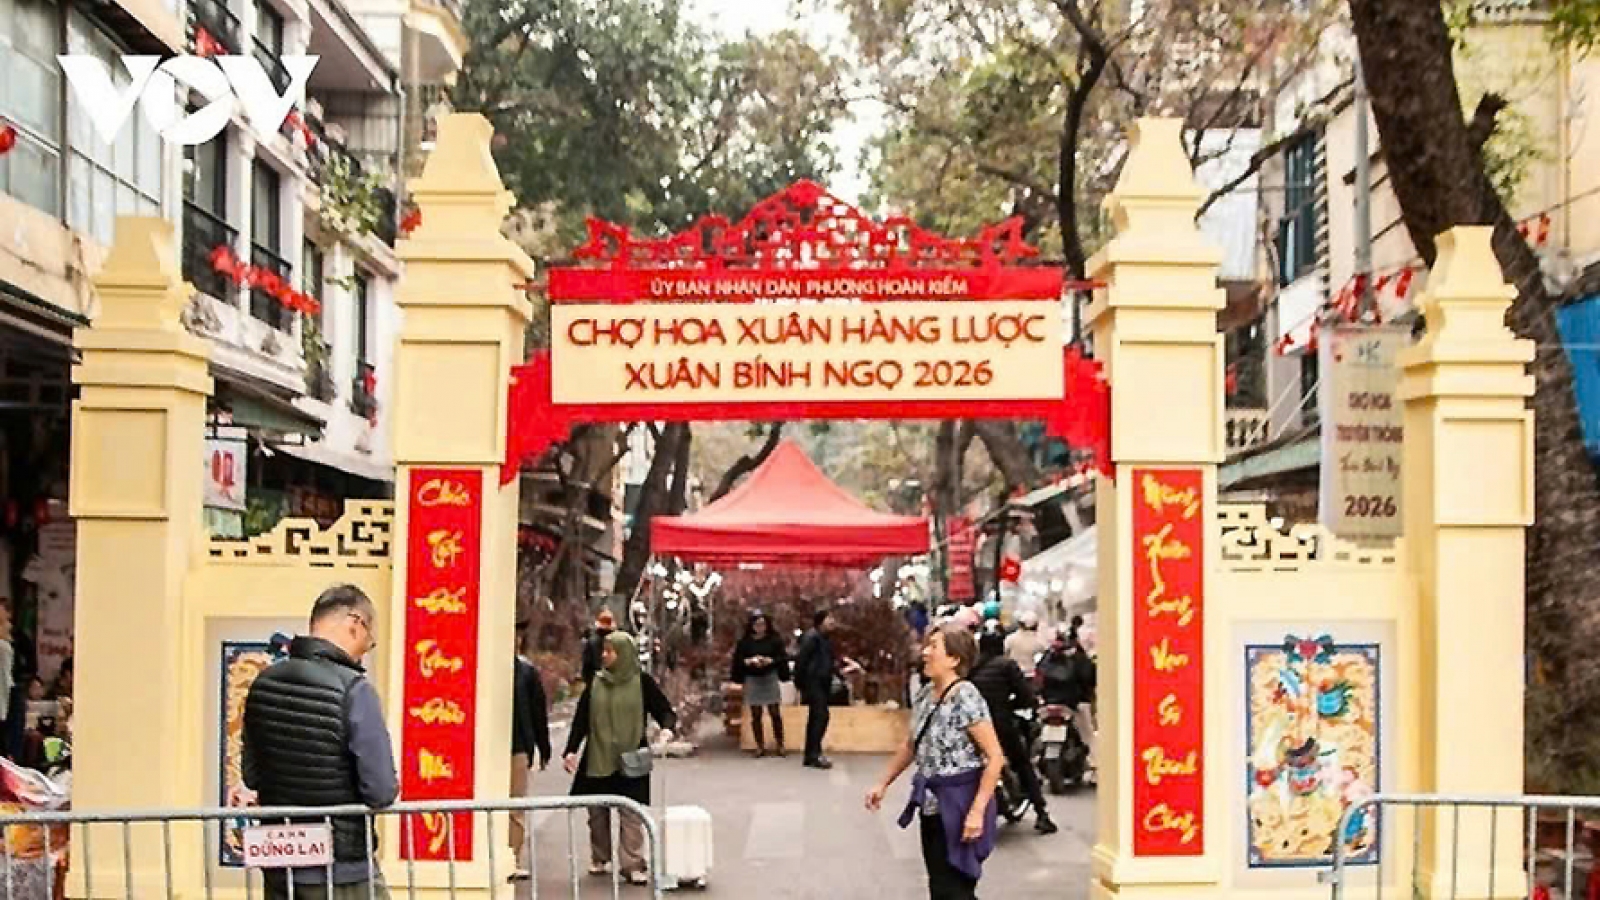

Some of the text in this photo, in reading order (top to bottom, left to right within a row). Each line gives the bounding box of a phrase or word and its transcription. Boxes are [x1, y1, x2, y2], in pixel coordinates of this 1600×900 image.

[675, 279, 711, 295] BAN
[714, 277, 761, 295] NHÂN
[764, 277, 801, 295] DÂN
[877, 277, 925, 295] HOÀN
[567, 309, 1046, 348] CHỢ HOA XUÂN HÀNG LƯỢC
[624, 354, 994, 390] XUÂN BÍNH NGỌ 2026
[1344, 495, 1397, 518] 2026
